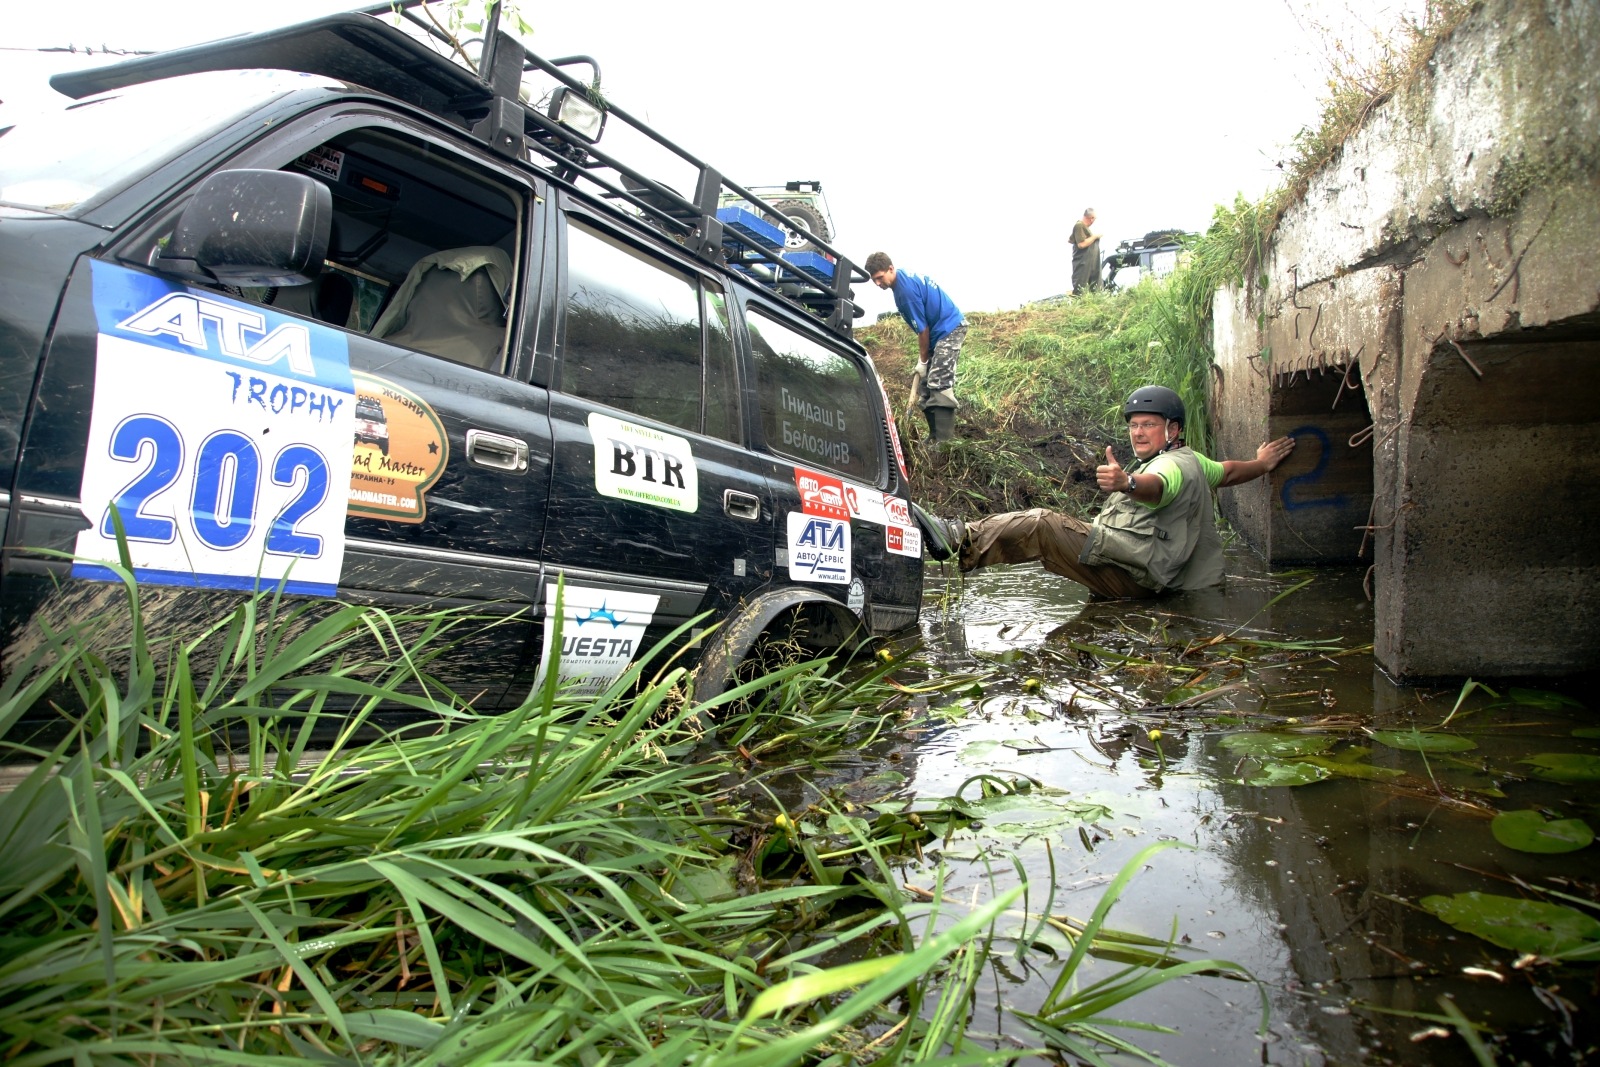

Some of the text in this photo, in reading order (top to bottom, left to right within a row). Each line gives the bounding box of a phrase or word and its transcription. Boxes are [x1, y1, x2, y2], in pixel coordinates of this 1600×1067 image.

[226, 371, 343, 423] TROPHY
[382, 387, 425, 418] ЖИЗНИ
[781, 387, 846, 432] Гнидаш Б
[379, 457, 425, 476] Master
[607, 437, 686, 490] BTR
[1280, 425, 1347, 512] 2
[99, 412, 332, 560] 202
[799, 476, 819, 492] АВТО
[804, 501, 848, 518] ЖУРНАЛ
[817, 573, 846, 581] www.atl.ua
